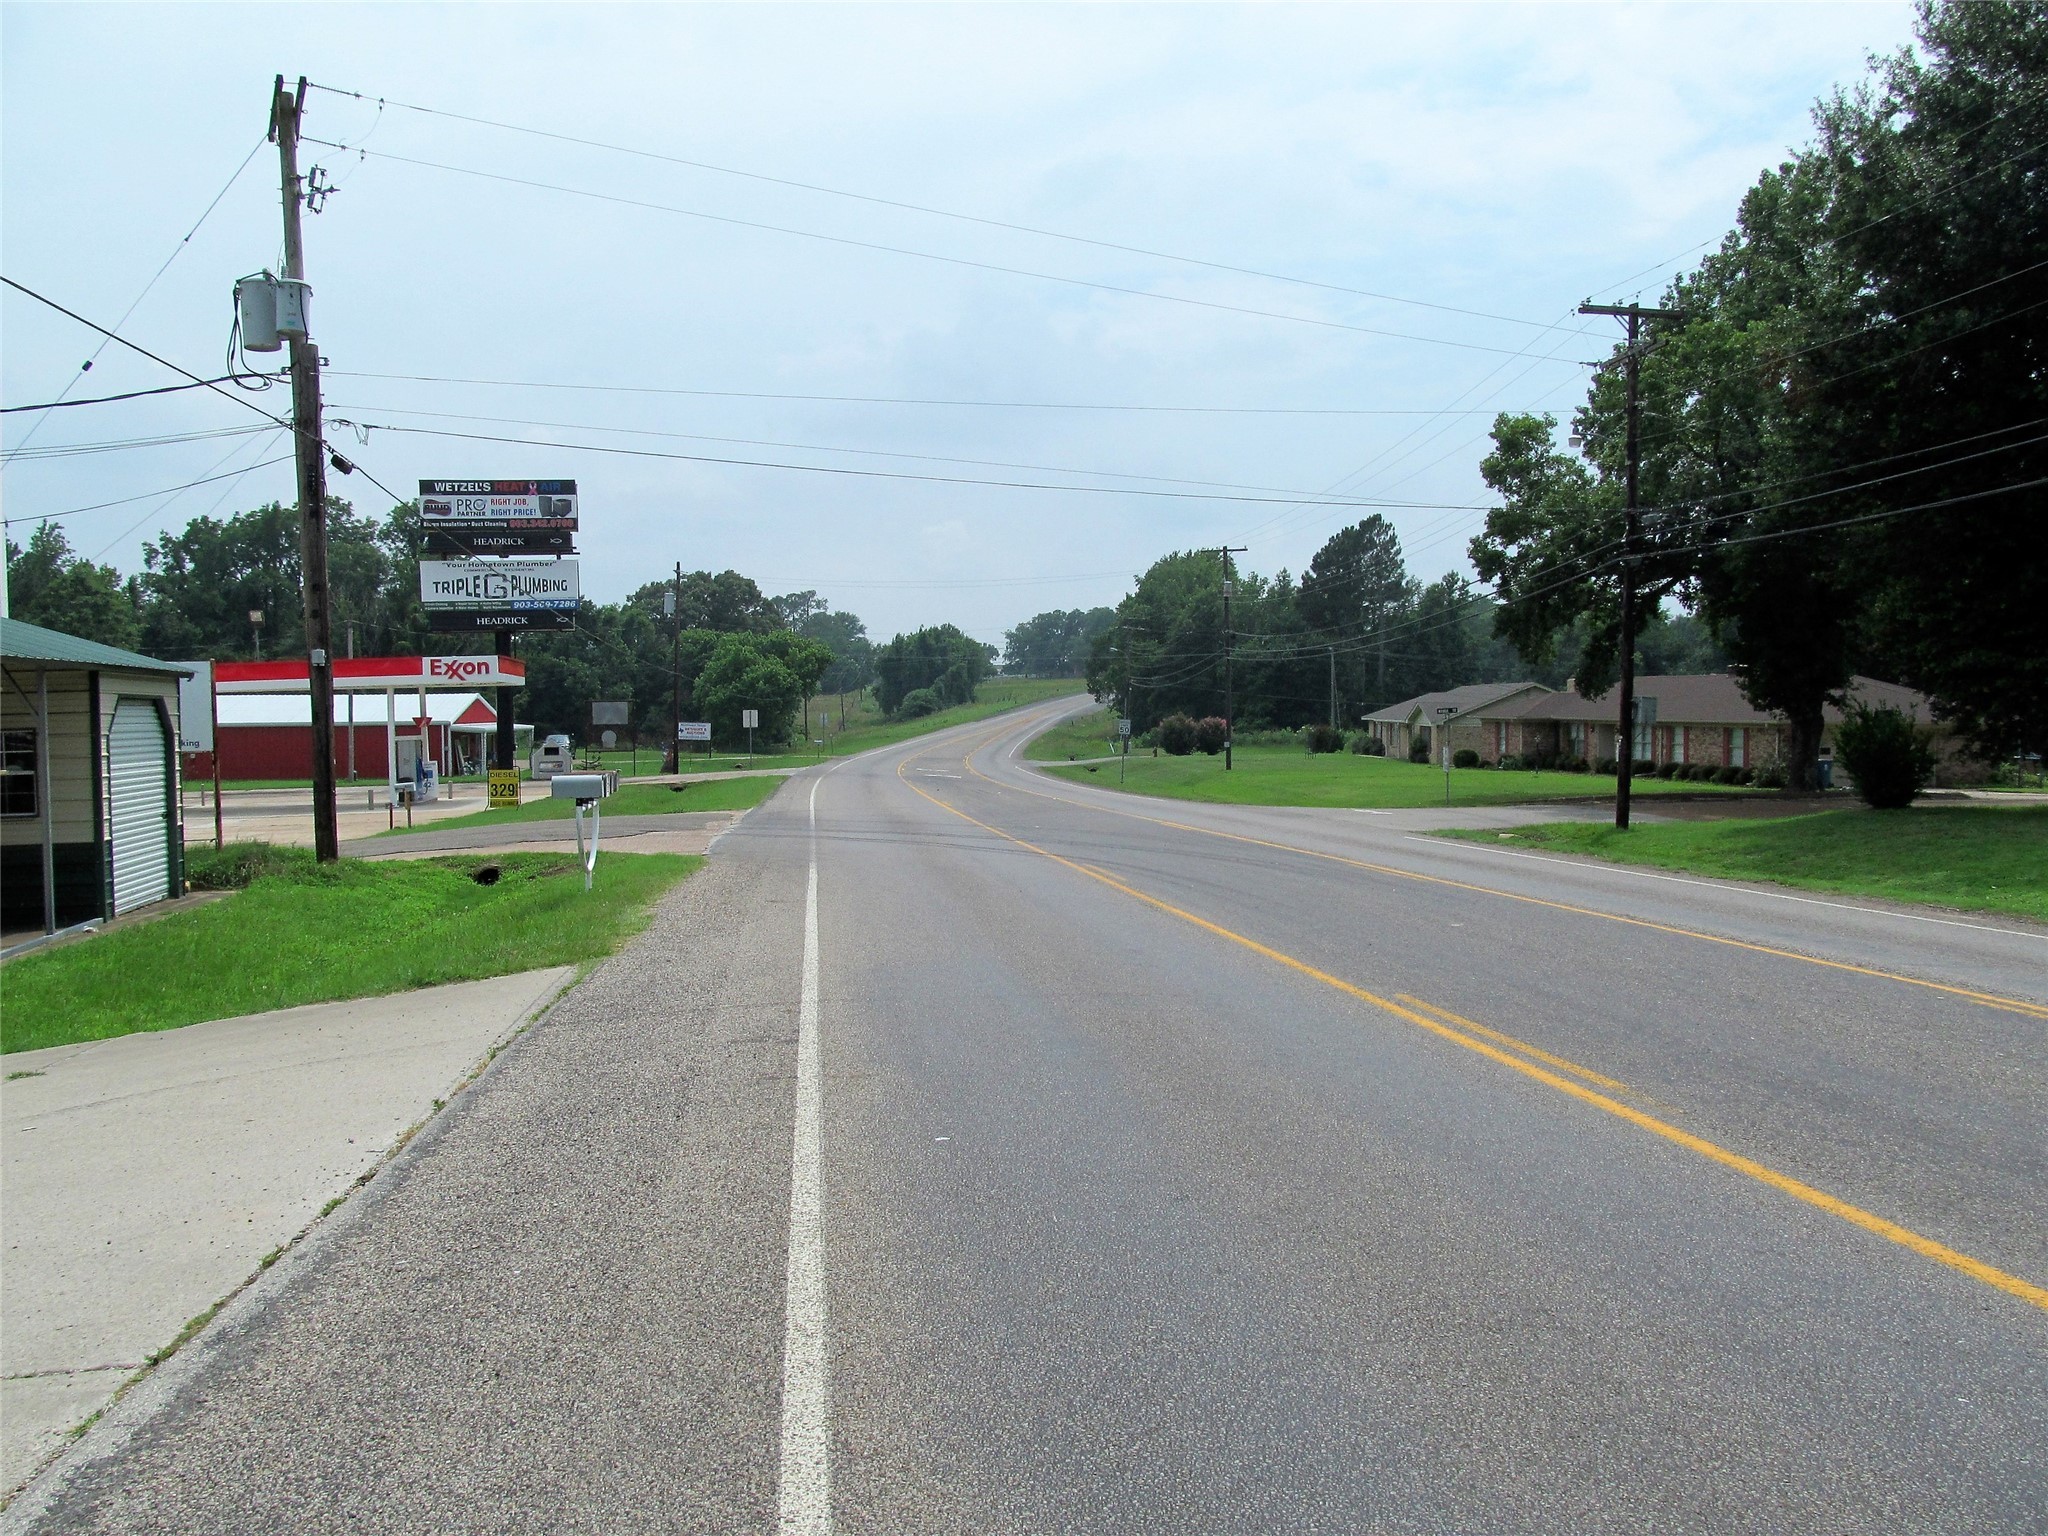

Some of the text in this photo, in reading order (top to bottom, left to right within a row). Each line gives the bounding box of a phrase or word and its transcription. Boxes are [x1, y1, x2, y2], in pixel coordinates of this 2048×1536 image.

[434, 482, 561, 492] WETZEL'S HEAT AIR
[456, 498, 487, 511] PRO
[490, 498, 529, 506] RIGHT JOB,
[490, 508, 536, 516] RIGHT PRICE!
[484, 520, 508, 528] Cleaning
[473, 537, 525, 546] HEADRICK
[433, 573, 568, 599] TRIPLE G PLUMBING
[476, 617, 528, 625] HEADRICK
[430, 658, 490, 681] Exxon
[490, 783, 515, 797] 329
